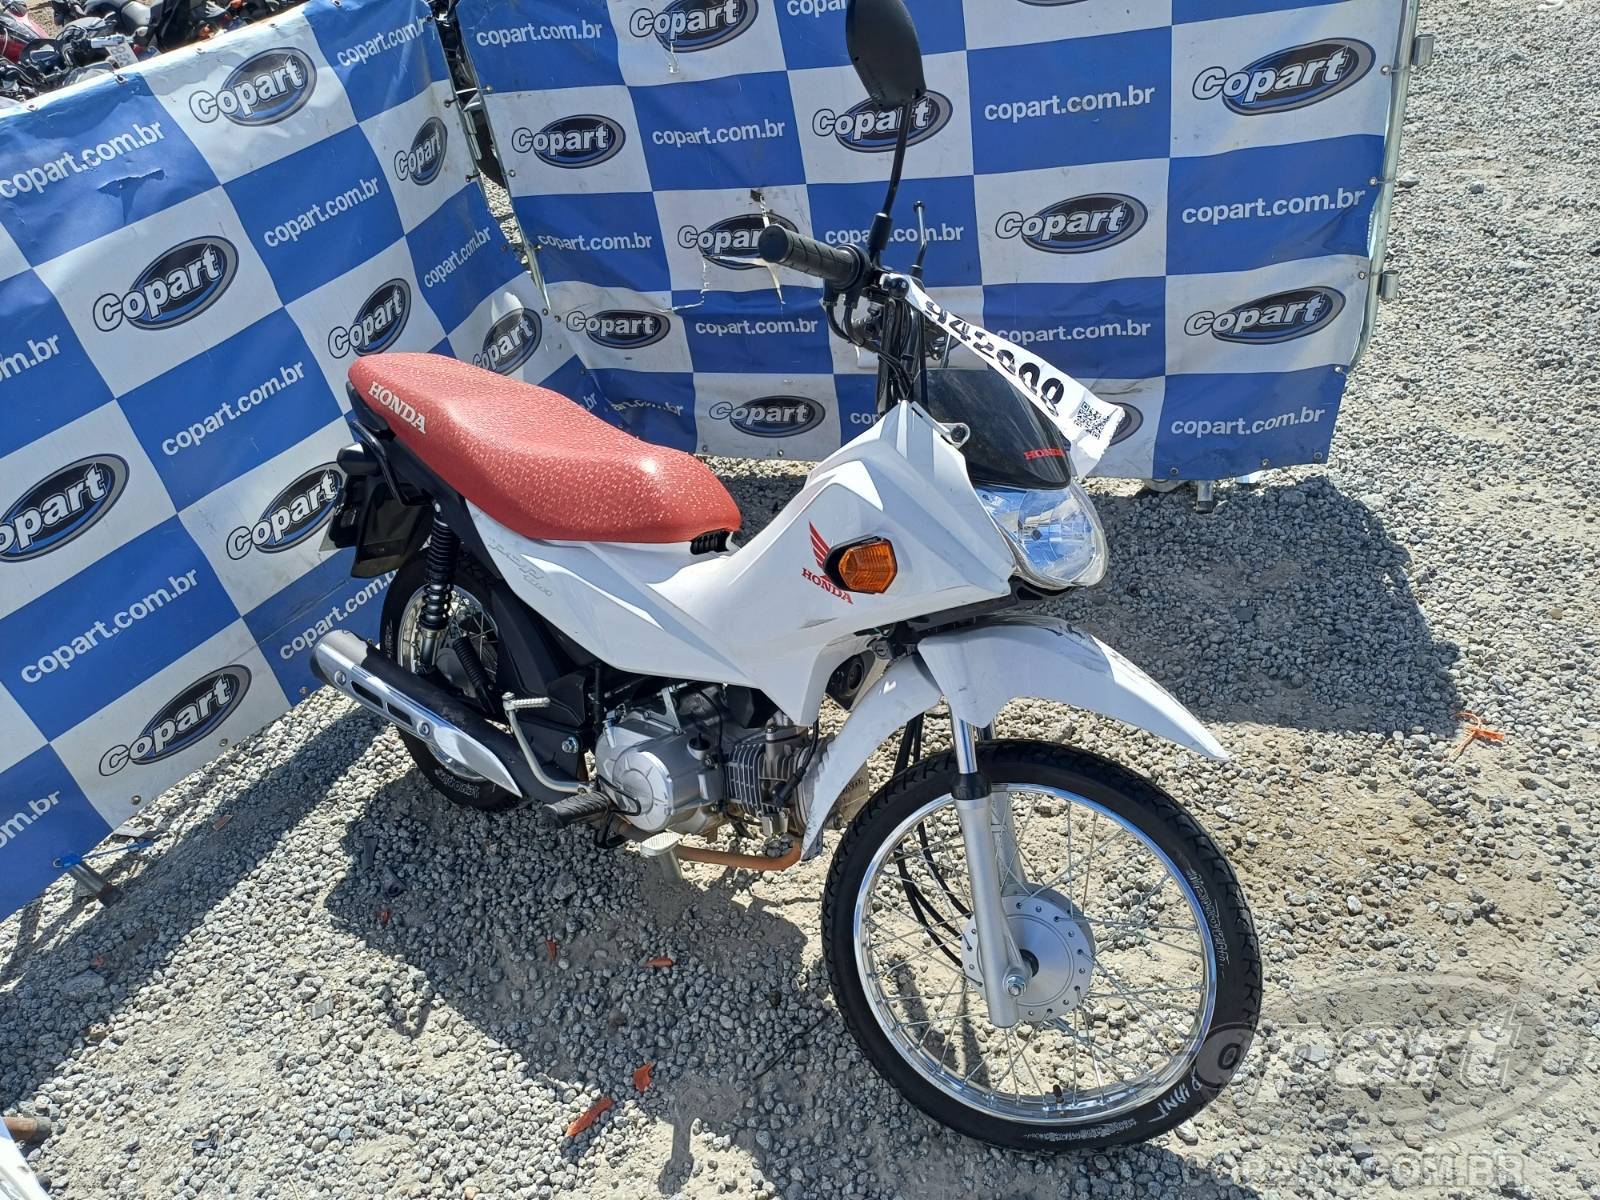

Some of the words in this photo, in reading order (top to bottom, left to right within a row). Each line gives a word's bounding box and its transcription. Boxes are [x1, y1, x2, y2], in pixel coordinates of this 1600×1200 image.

[476, 20, 602, 47] copart.com.br
[629, 0, 740, 41] Copart
[189, 55, 304, 123] Copart
[1192, 45, 1351, 104] Copart
[984, 85, 1155, 123] copart.com.br
[394, 127, 442, 180] Copart
[512, 124, 608, 156] Copart
[652, 119, 785, 148] copart.com.br
[0, 120, 163, 198] copart.com.br
[264, 175, 380, 247] copart.com.br
[995, 202, 1128, 242] Copart
[1182, 188, 1365, 224] copart.com.br
[538, 233, 652, 251] copart.com.br
[825, 223, 964, 245] copa.com.br
[424, 227, 490, 288] copart.com.br
[93, 244, 222, 332] Copart
[328, 283, 402, 359] Copart
[566, 310, 655, 341] Copart
[695, 318, 818, 336] copart.com.br
[996, 319, 1152, 345] copart.com.br
[1184, 295, 1325, 337] Copart
[162, 359, 304, 456] copart.com.br
[368, 381, 427, 434] HONDA
[709, 400, 807, 424] Copart
[1171, 406, 1325, 438] copart.com.br
[226, 468, 338, 560] Copart
[802, 567, 854, 604] HONDA
[21, 567, 198, 684] copart.com.br
[280, 569, 399, 659] copart.com.b
[99, 673, 233, 777] Copart
